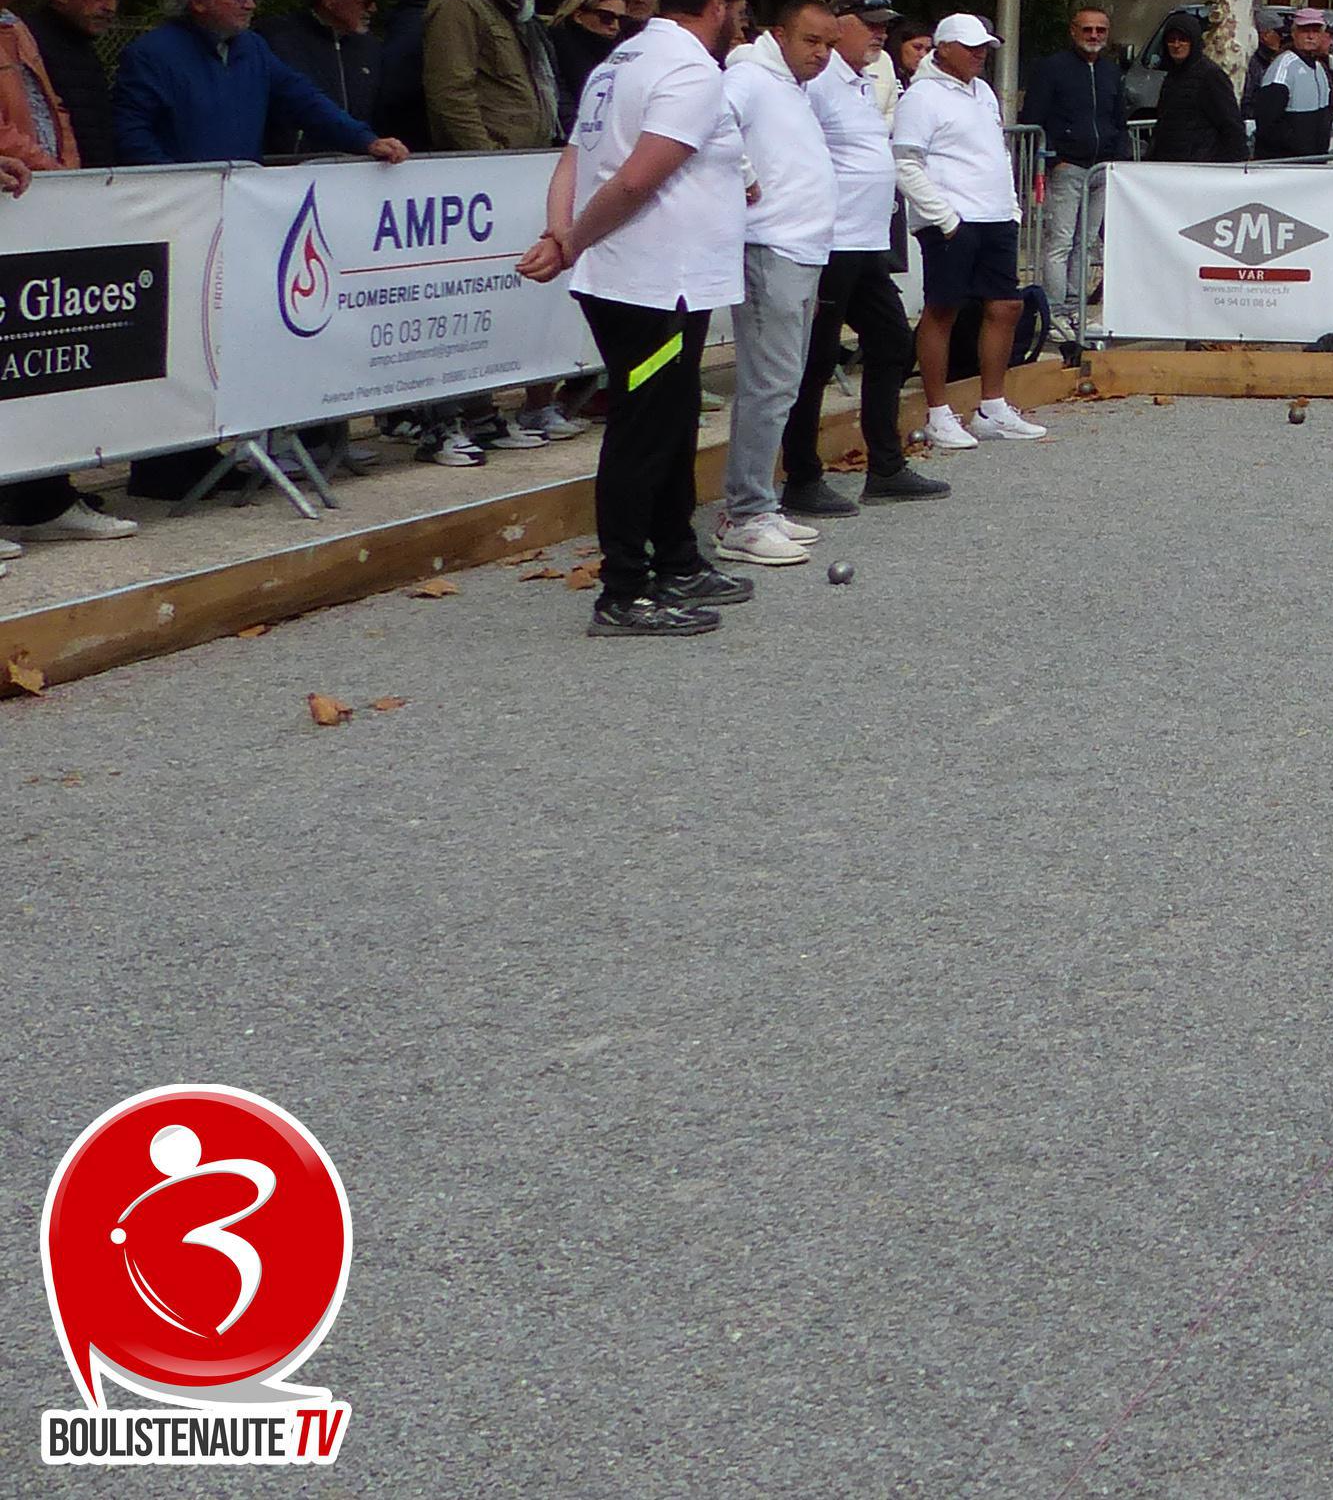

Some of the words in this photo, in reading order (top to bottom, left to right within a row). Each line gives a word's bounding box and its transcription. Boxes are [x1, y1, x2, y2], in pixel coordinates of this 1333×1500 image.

[373, 193, 493, 251] AMPC
[1213, 213, 1295, 255] SMF
[338, 284, 419, 310] PLOMBERIE
[424, 273, 522, 300] CLIMATISATION
[1238, 270, 1265, 280] VAR
[1214, 298, 1225, 306] 04
[371, 323, 393, 348] 06
[400, 319, 421, 343] 03
[427, 316, 447, 340] 78
[453, 313, 468, 336] 71
[473, 310, 492, 332] 76
